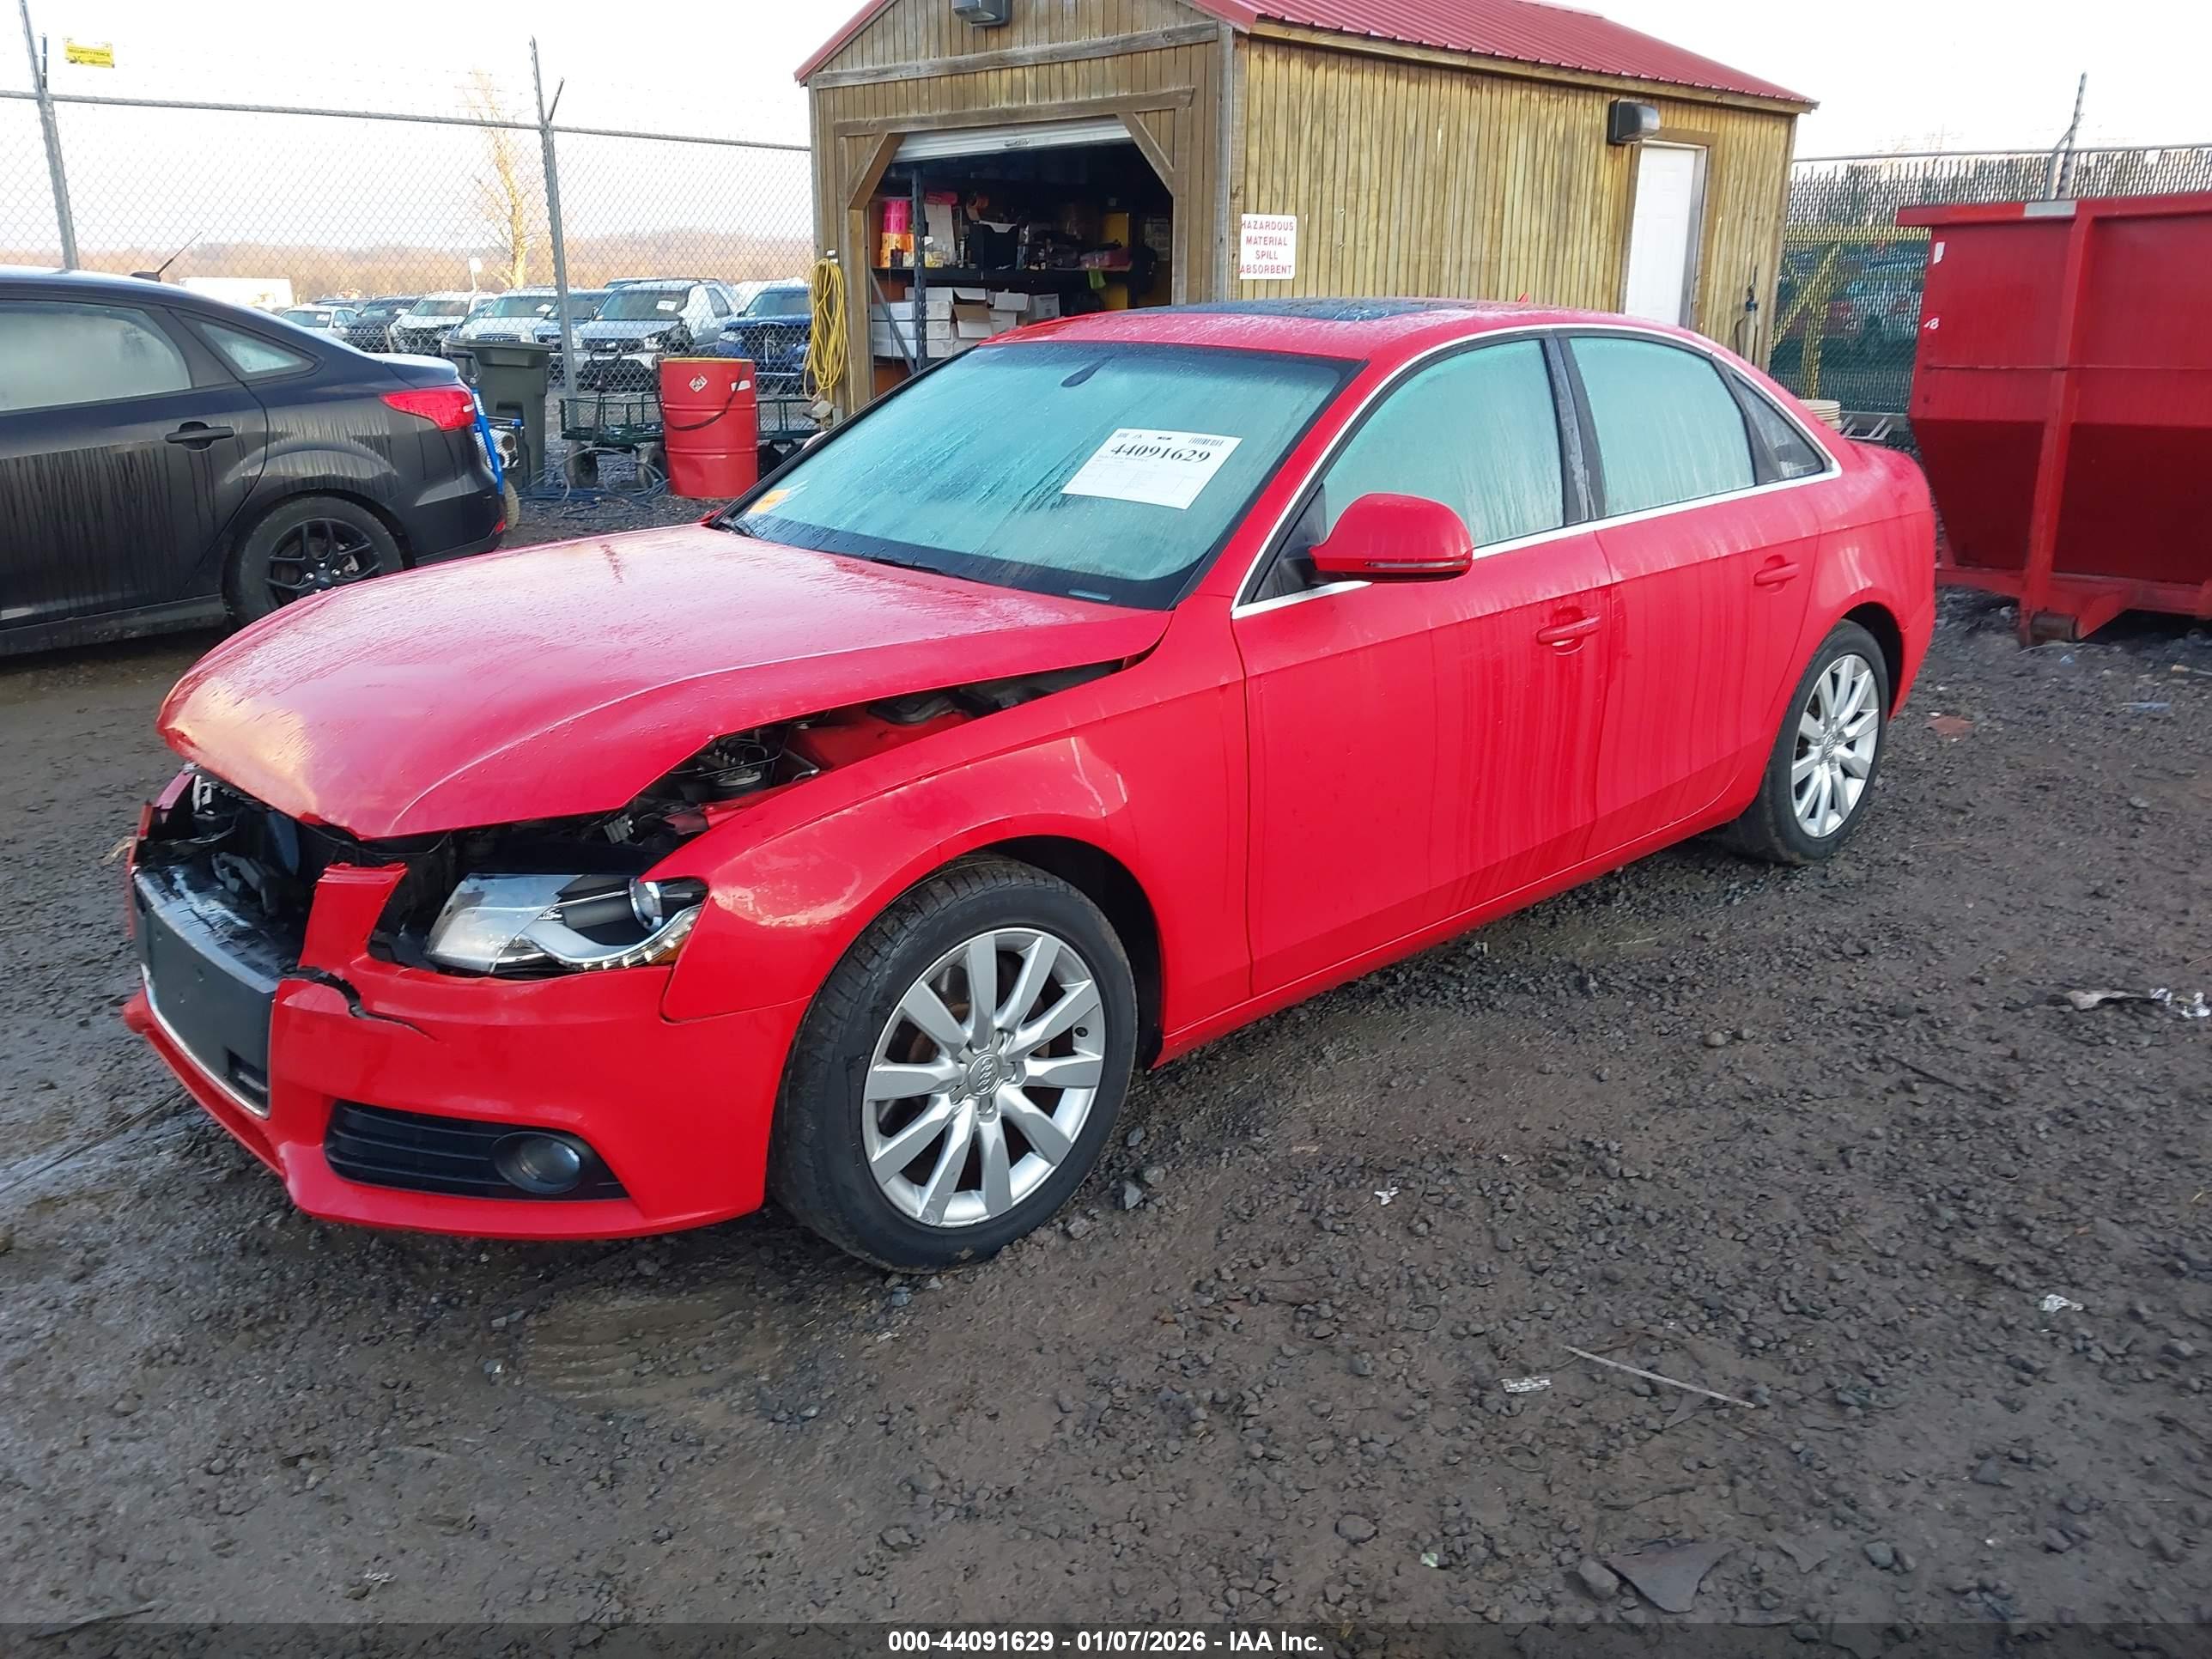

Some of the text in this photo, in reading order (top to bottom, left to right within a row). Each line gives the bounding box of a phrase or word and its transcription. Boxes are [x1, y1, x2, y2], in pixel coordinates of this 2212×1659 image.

[1246, 235, 1288, 246] MATERIAL
[1255, 250, 1279, 260] SPILL
[1240, 264, 1292, 274] ABSORBENT
[1110, 443, 1212, 463] 44091629
